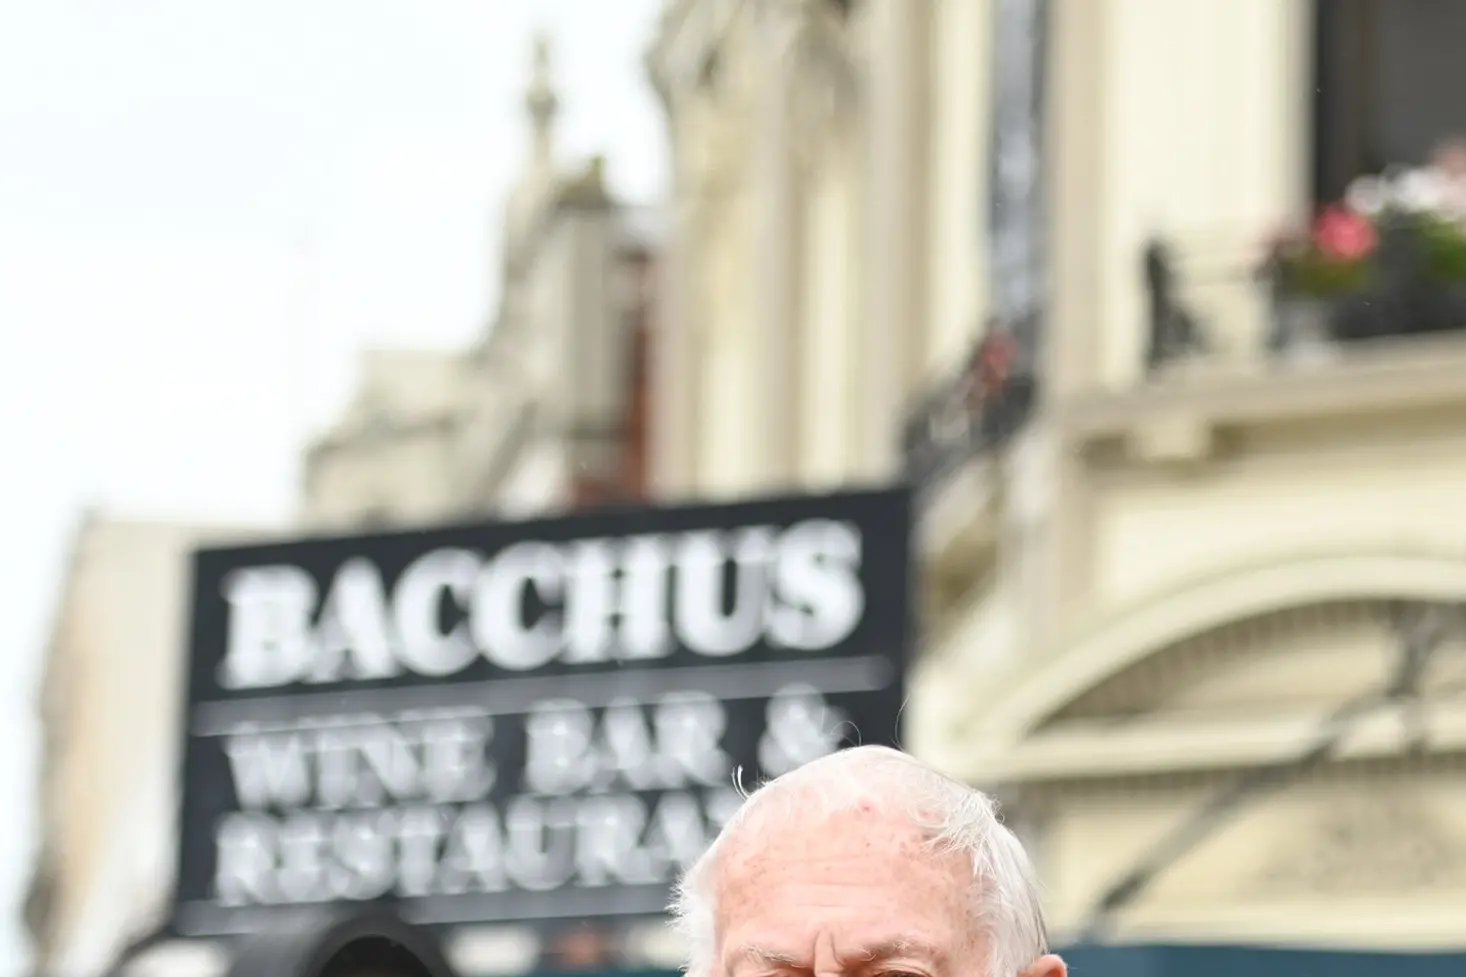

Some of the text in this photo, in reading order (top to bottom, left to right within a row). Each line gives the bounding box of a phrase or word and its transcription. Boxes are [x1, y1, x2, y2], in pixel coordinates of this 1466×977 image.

[218, 517, 865, 690] BACCHUS
[225, 706, 496, 810] WINE
[524, 688, 732, 797] BAR
